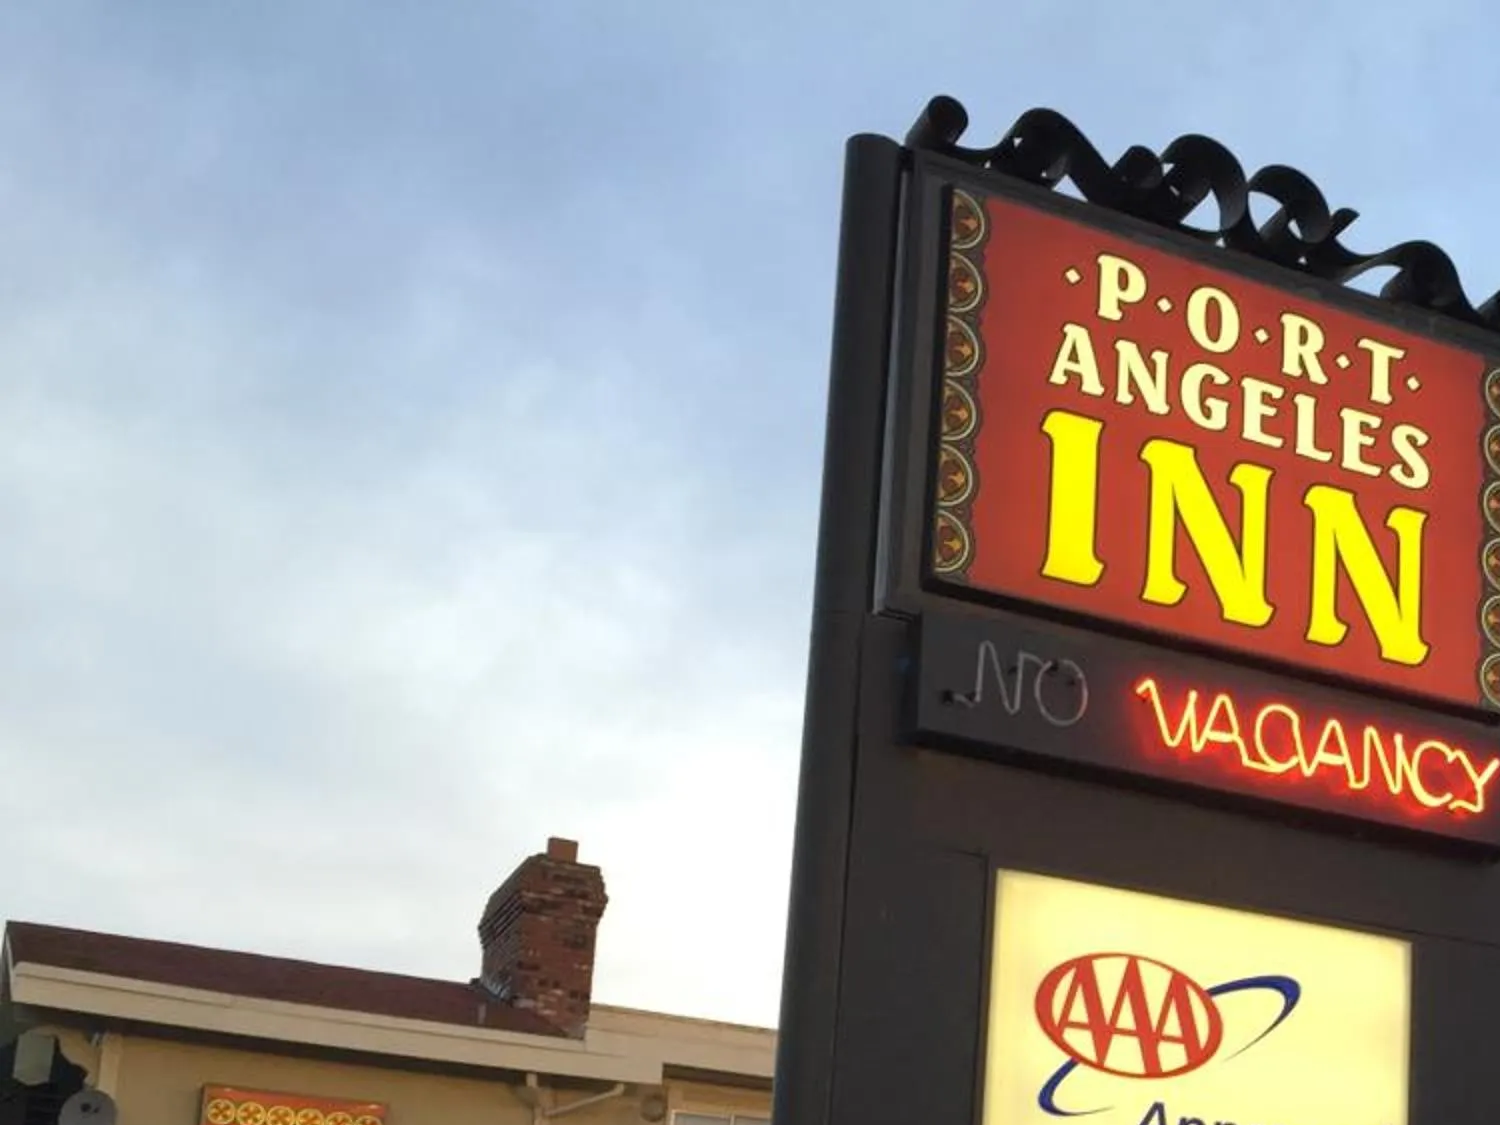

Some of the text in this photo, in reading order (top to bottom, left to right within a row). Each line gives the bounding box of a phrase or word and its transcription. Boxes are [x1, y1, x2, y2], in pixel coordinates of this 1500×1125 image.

[1049, 322, 1431, 490] ANGELES
[1040, 409, 1430, 667] INN
[966, 639, 1500, 813] NO VACANCY
[1048, 954, 1212, 1078] AAA
